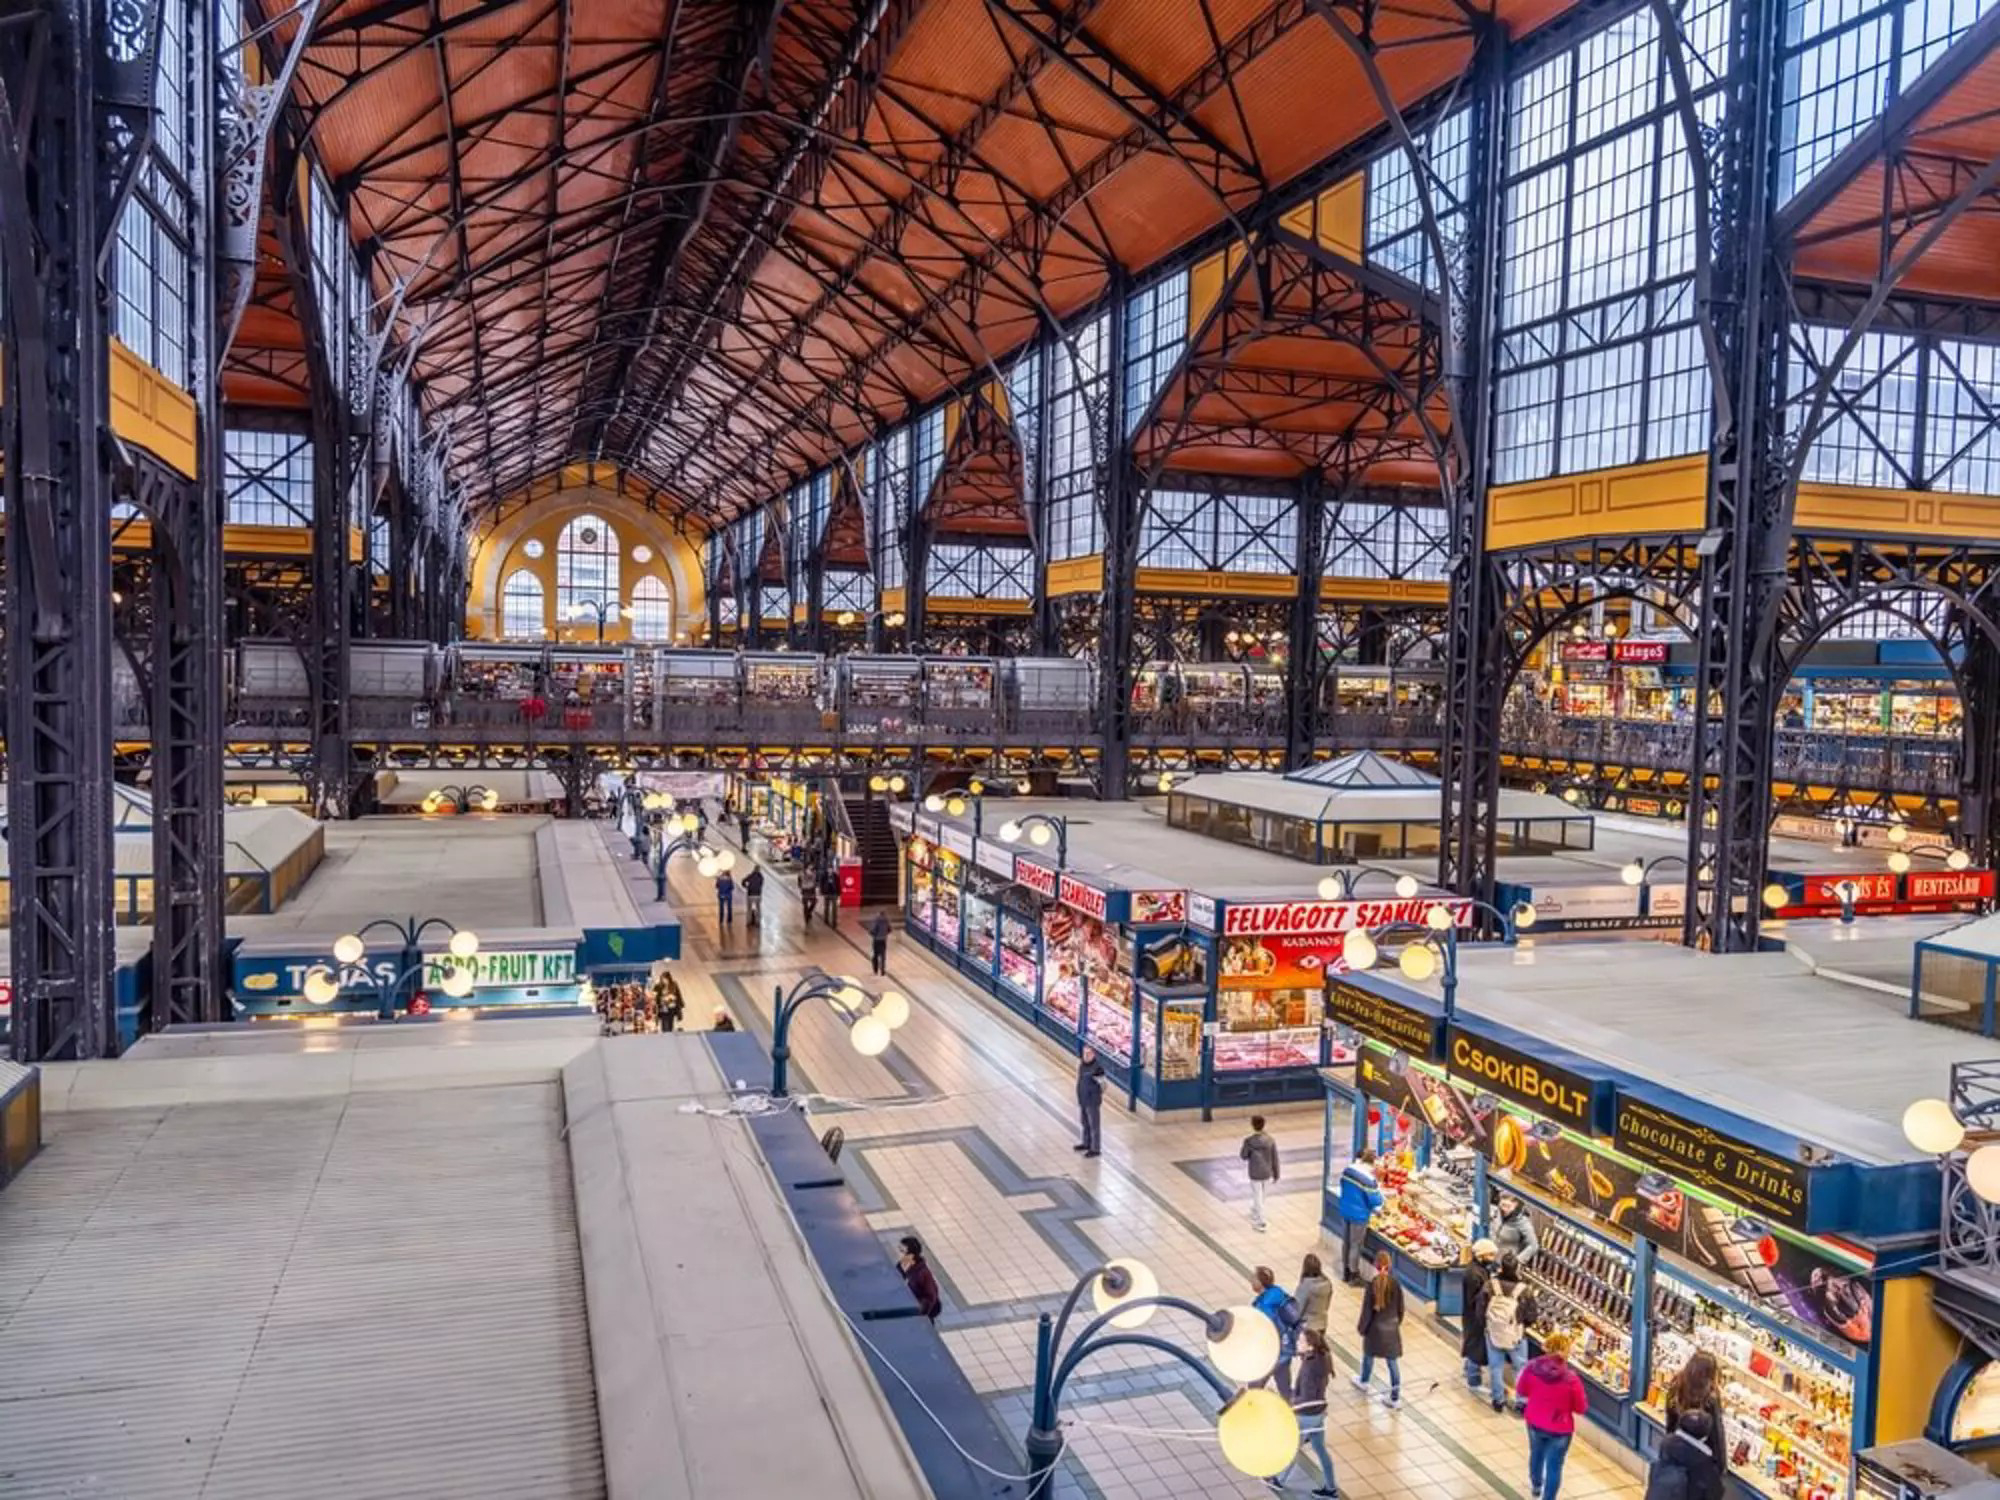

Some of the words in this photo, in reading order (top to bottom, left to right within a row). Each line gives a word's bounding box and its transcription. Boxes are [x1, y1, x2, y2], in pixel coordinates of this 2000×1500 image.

[1226, 903, 1349, 933] FELVÁGOTT
[1356, 899, 1472, 928] SZAKÜZT
[1618, 1112, 1706, 1163] Chocolate
[1713, 1151, 1727, 1171] &
[1735, 1160, 1804, 1205] Drinks
